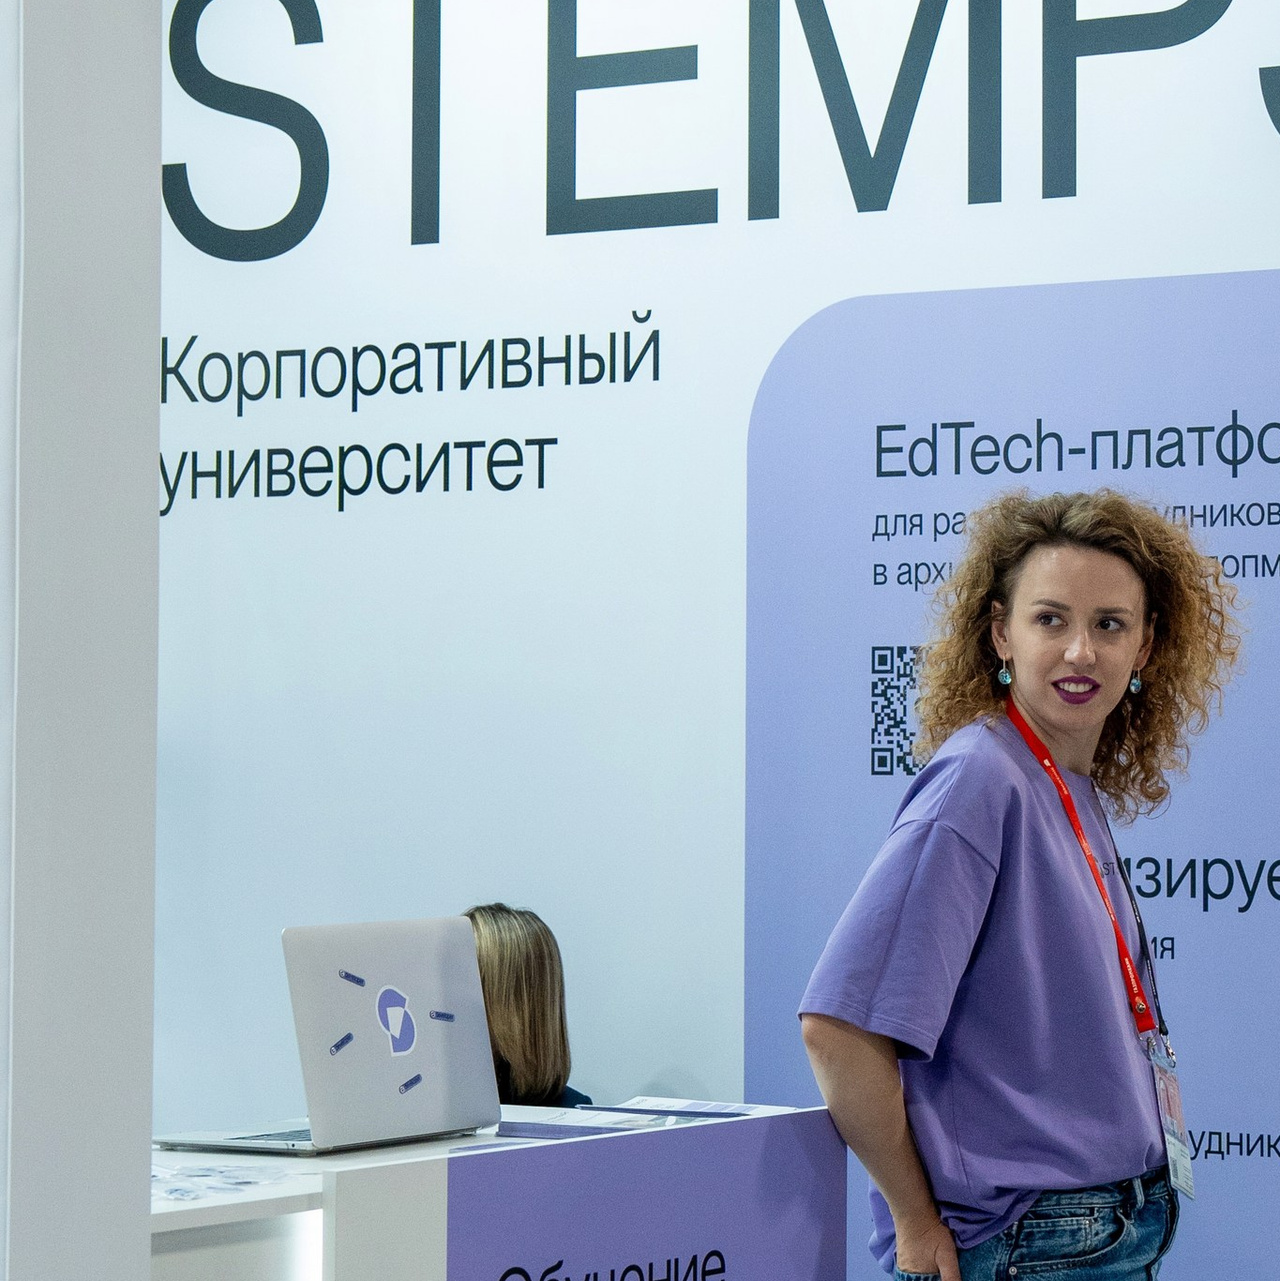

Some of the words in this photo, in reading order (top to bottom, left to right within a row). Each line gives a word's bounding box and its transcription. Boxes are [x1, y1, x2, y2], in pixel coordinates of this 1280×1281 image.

[161, 310, 659, 417] Корпоративный
[160, 438, 557, 516] университет
[872, 514, 922, 541] для
[874, 564, 887, 585] в
